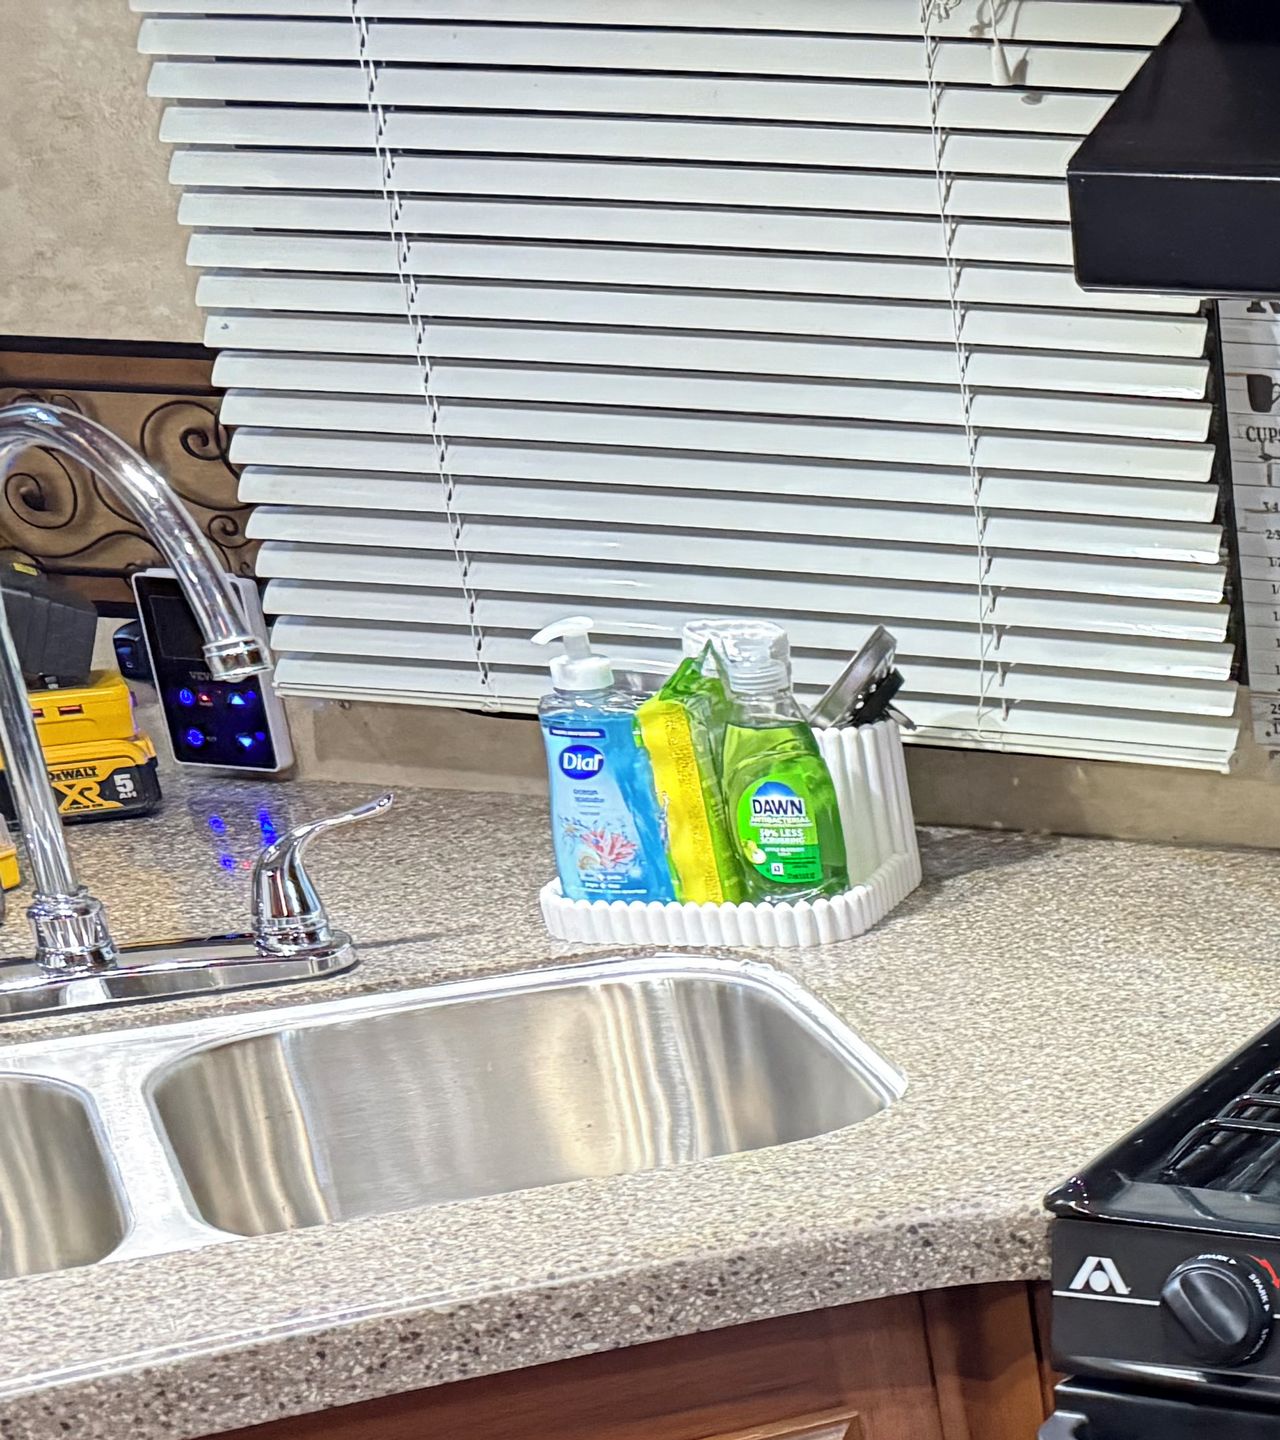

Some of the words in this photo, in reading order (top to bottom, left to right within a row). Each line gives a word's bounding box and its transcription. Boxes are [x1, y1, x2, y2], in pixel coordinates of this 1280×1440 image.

[562, 752, 604, 771] Dial
[113, 773, 134, 793] 5
[752, 799, 803, 815] DAWN
